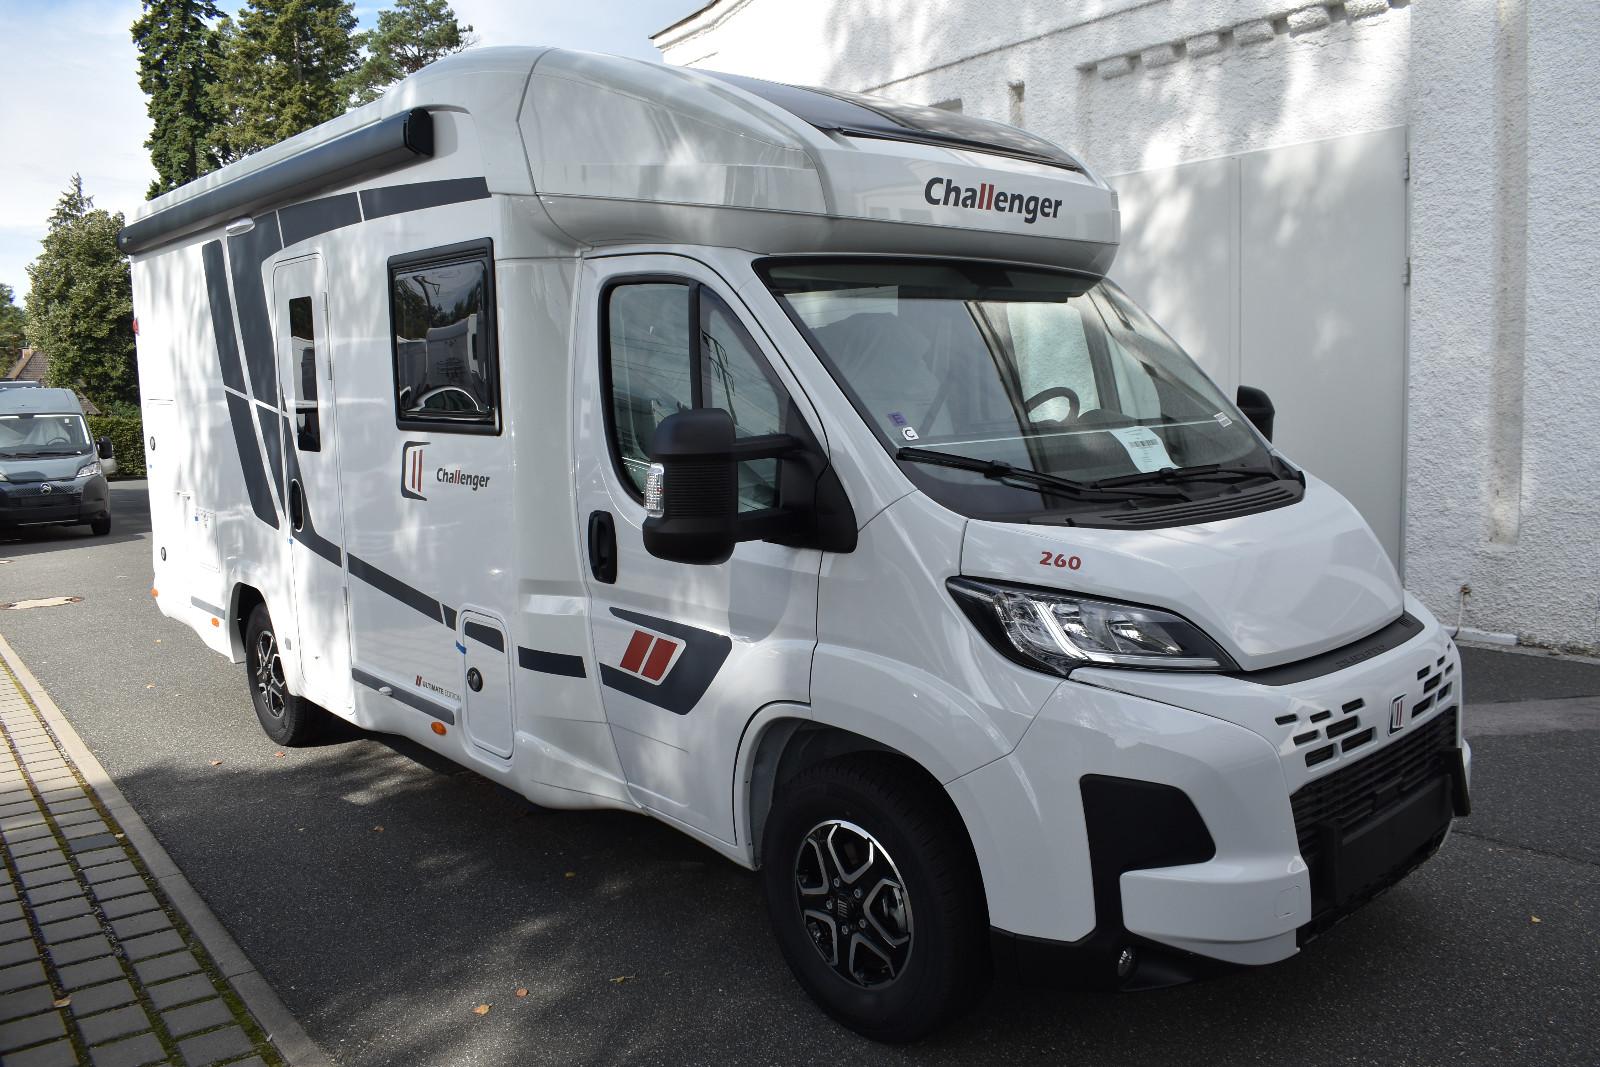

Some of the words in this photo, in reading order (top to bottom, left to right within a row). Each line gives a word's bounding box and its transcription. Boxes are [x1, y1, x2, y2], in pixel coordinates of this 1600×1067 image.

[924, 177, 1063, 224] Challenger
[436, 467, 490, 491] Challenger
[1039, 551, 1082, 570] 260
[422, 681, 444, 694] ULTIMATE
